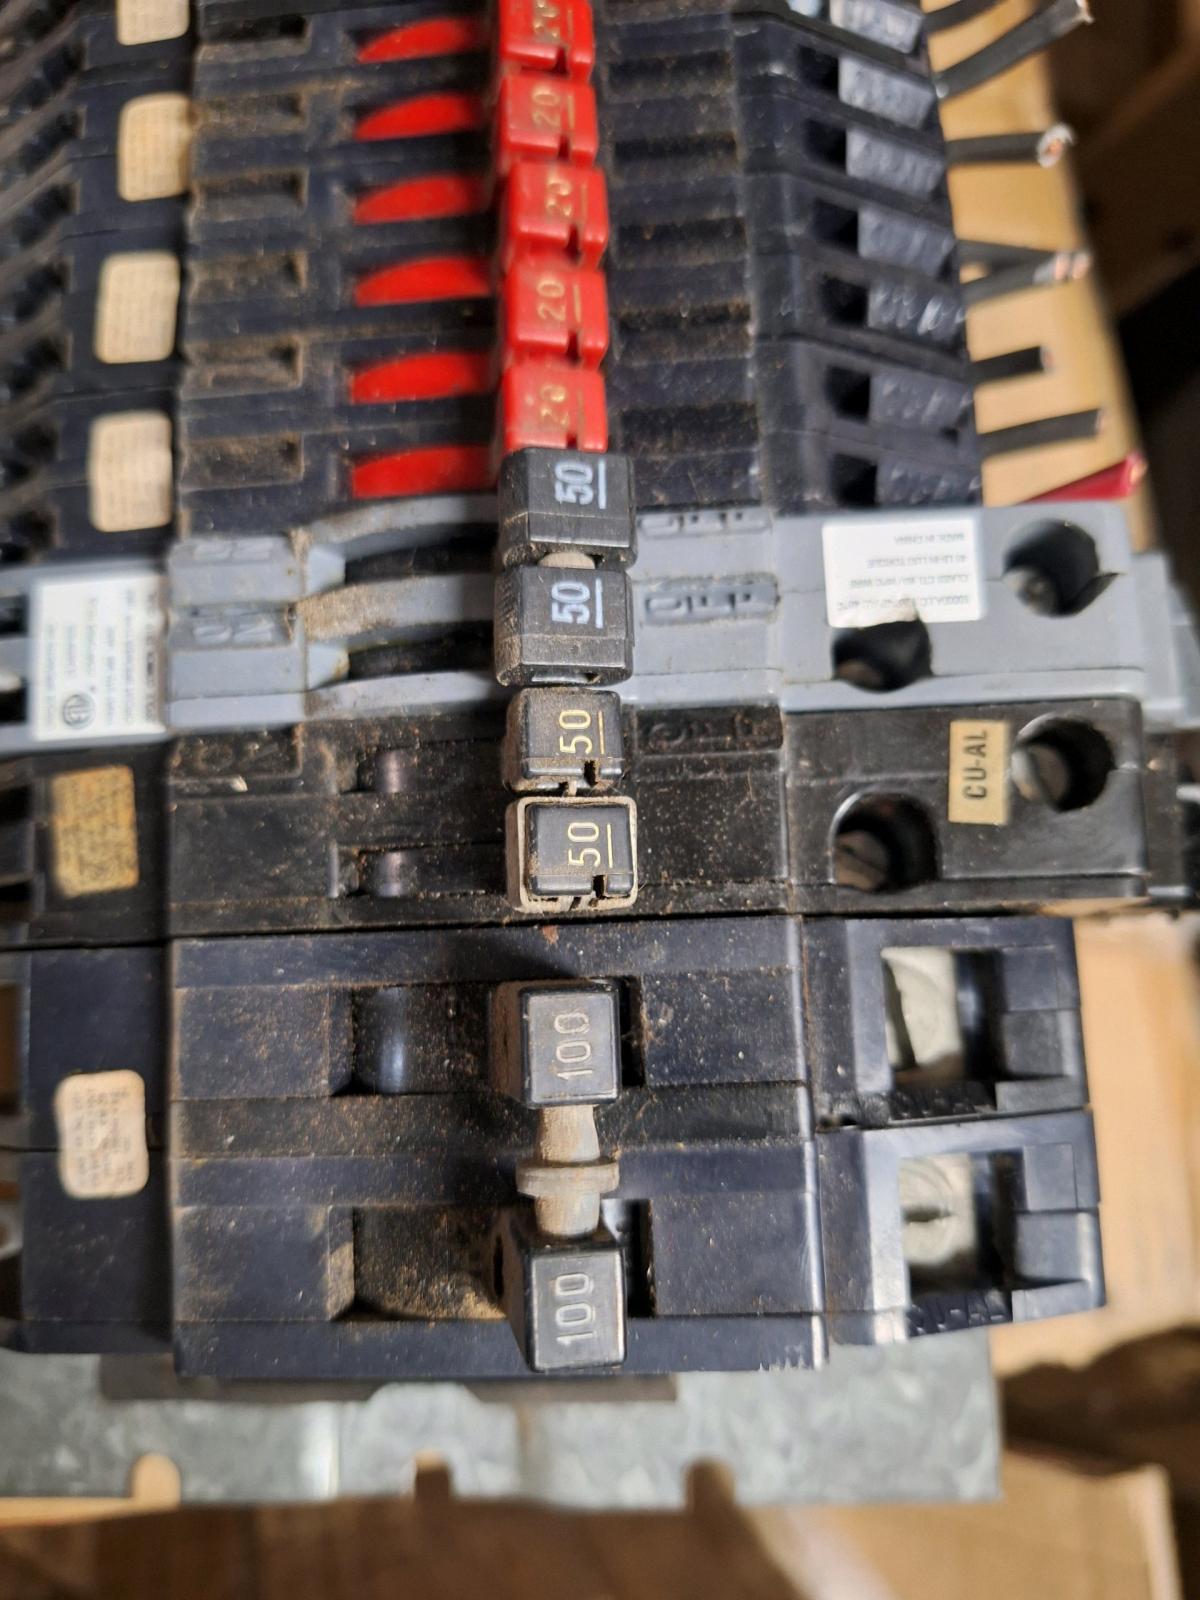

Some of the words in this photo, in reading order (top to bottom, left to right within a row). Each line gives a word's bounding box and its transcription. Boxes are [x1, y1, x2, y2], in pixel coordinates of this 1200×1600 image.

[532, 86, 561, 130] 20
[537, 278, 567, 323] 20
[540, 383, 570, 428] 20
[553, 460, 595, 505] 50
[551, 580, 591, 625] 50
[558, 709, 593, 755] 50
[963, 729, 989, 801] CU-AL
[567, 821, 602, 868] 50
[553, 1011, 594, 1081] 100
[554, 1272, 595, 1345] 100
